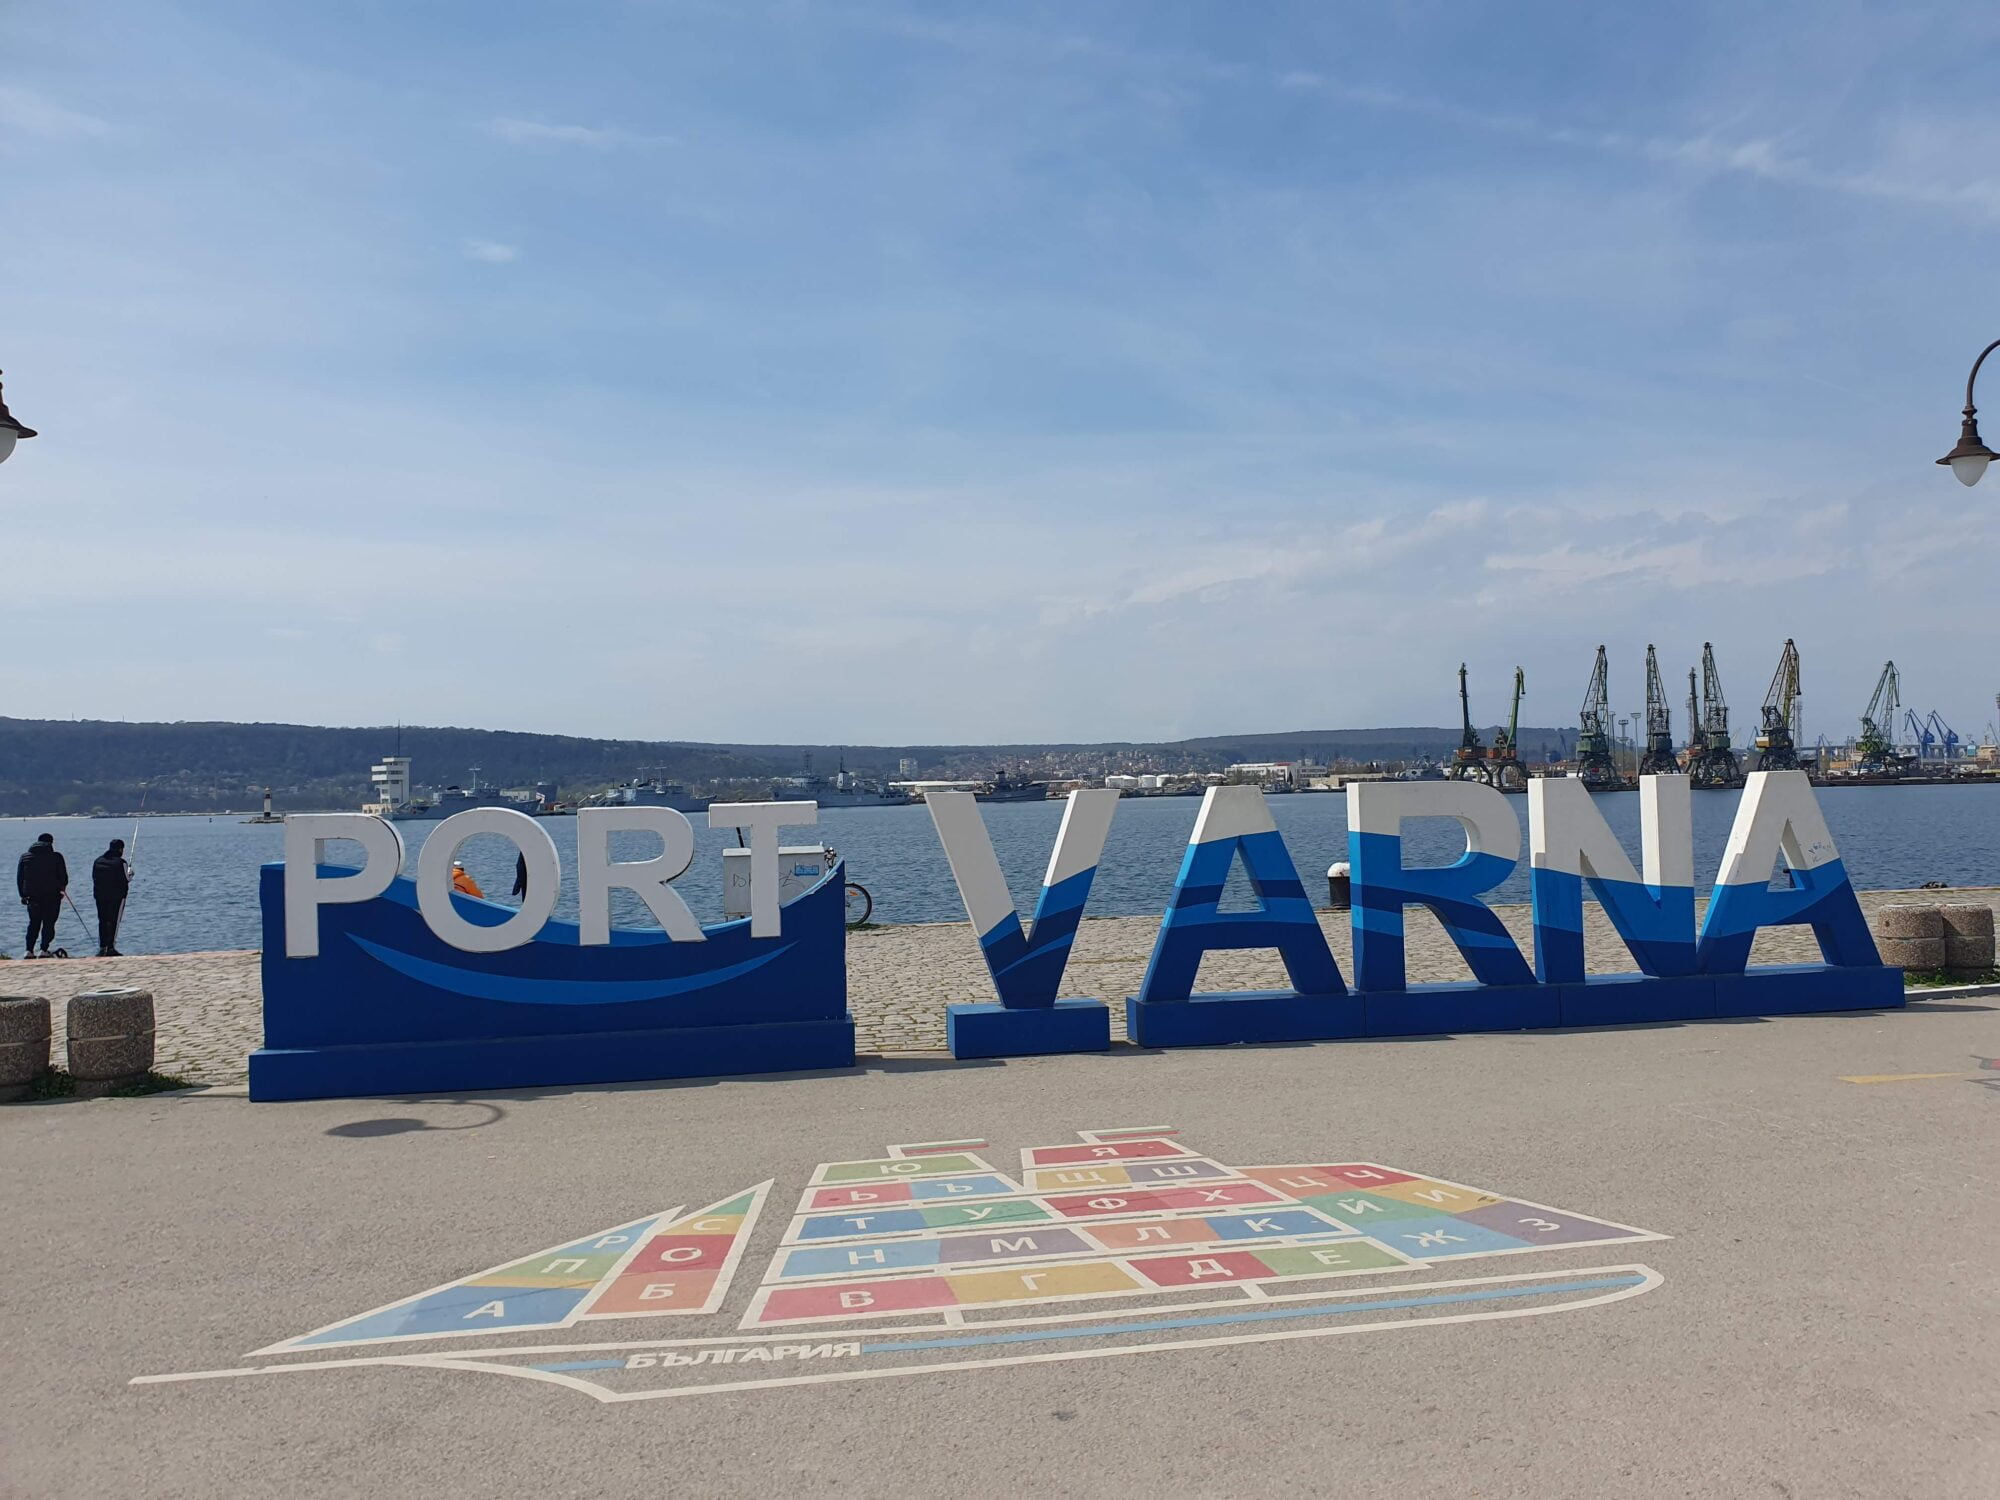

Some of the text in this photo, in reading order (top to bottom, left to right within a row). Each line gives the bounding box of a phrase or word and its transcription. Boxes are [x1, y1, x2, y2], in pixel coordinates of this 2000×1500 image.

[285, 770, 1886, 1009] PORT VARNA
[1091, 1147, 1118, 1156] Я
[879, 1163, 921, 1174] Ю
[1151, 1164, 1197, 1177] Ш
[1057, 1171, 1106, 1183] Щ
[1285, 1176, 1328, 1188] Ц
[1343, 1170, 1385, 1182] Ч
[937, 1183, 974, 1193] Ъ
[1413, 1188, 1460, 1202] И
[850, 1191, 878, 1201] Ь
[1198, 1189, 1234, 1202] Х
[1087, 1198, 1128, 1210] Ф
[1336, 1198, 1384, 1215] Й
[967, 1207, 993, 1221] У
[692, 1218, 727, 1231] С
[845, 1217, 875, 1230] Т
[1243, 1218, 1284, 1233] К
[1517, 1218, 1560, 1232] З
[1136, 1226, 1172, 1241] Л
[1403, 1229, 1467, 1247] Ж
[594, 1235, 630, 1249] Р
[990, 1236, 1039, 1252] М
[660, 1248, 703, 1262] О
[848, 1249, 886, 1265] Н
[1310, 1249, 1351, 1265] Е
[540, 1258, 587, 1274] П
[1188, 1258, 1234, 1278] Д
[1020, 1273, 1047, 1291] Г
[637, 1283, 677, 1300] Б
[839, 1291, 875, 1308] В
[462, 1300, 506, 1319] А
[624, 1341, 862, 1369] БЪЛГАРИЯ
